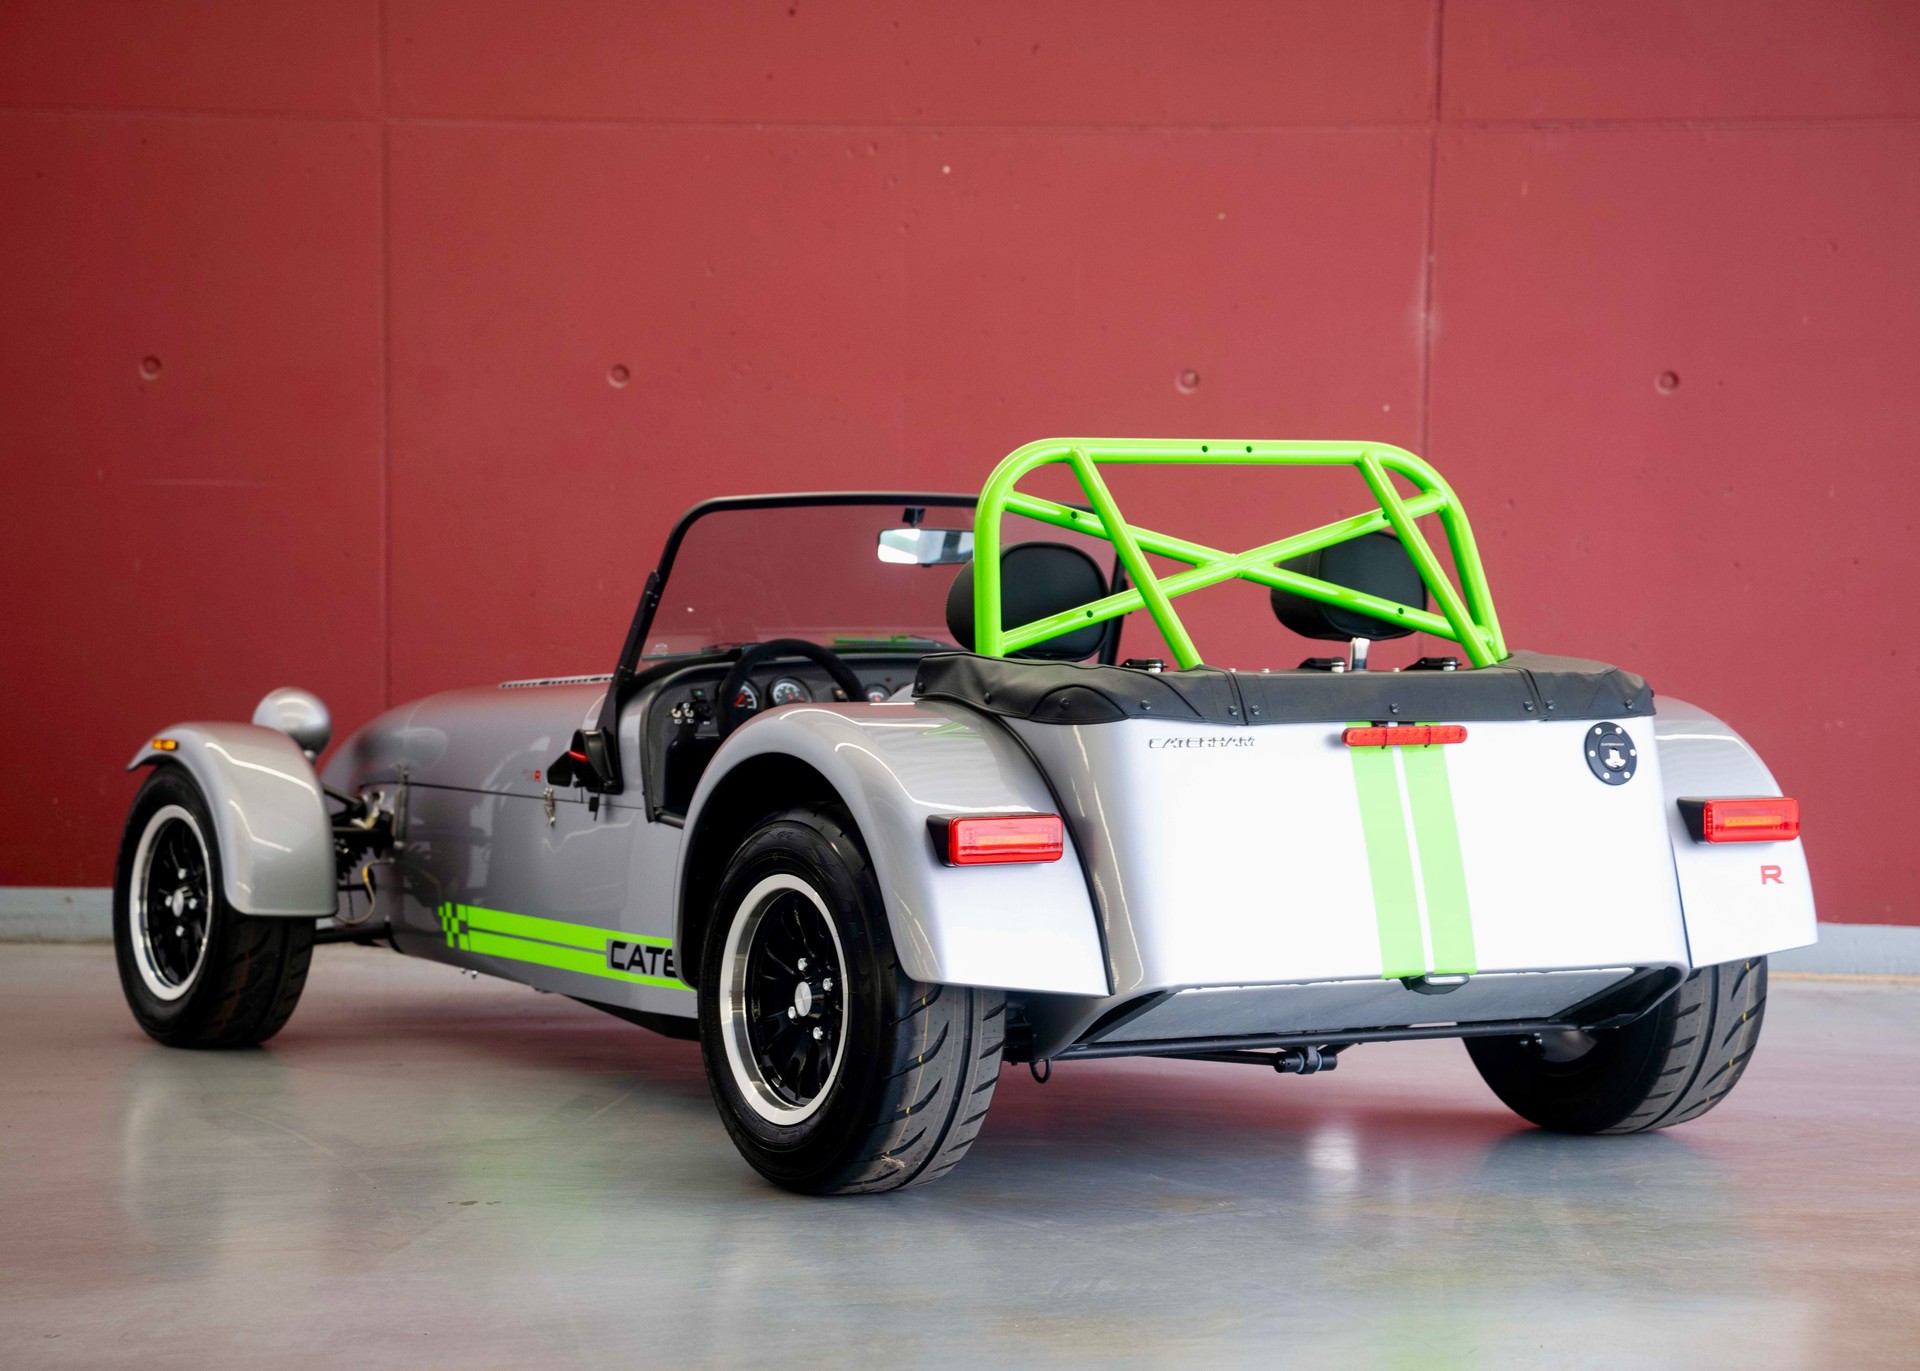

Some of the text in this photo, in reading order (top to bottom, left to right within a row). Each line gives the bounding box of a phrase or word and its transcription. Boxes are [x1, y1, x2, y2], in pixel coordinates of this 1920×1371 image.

[1148, 737, 1256, 749] CATERHAM
[1760, 865, 1784, 885] R
[610, 940, 678, 978] CATE
